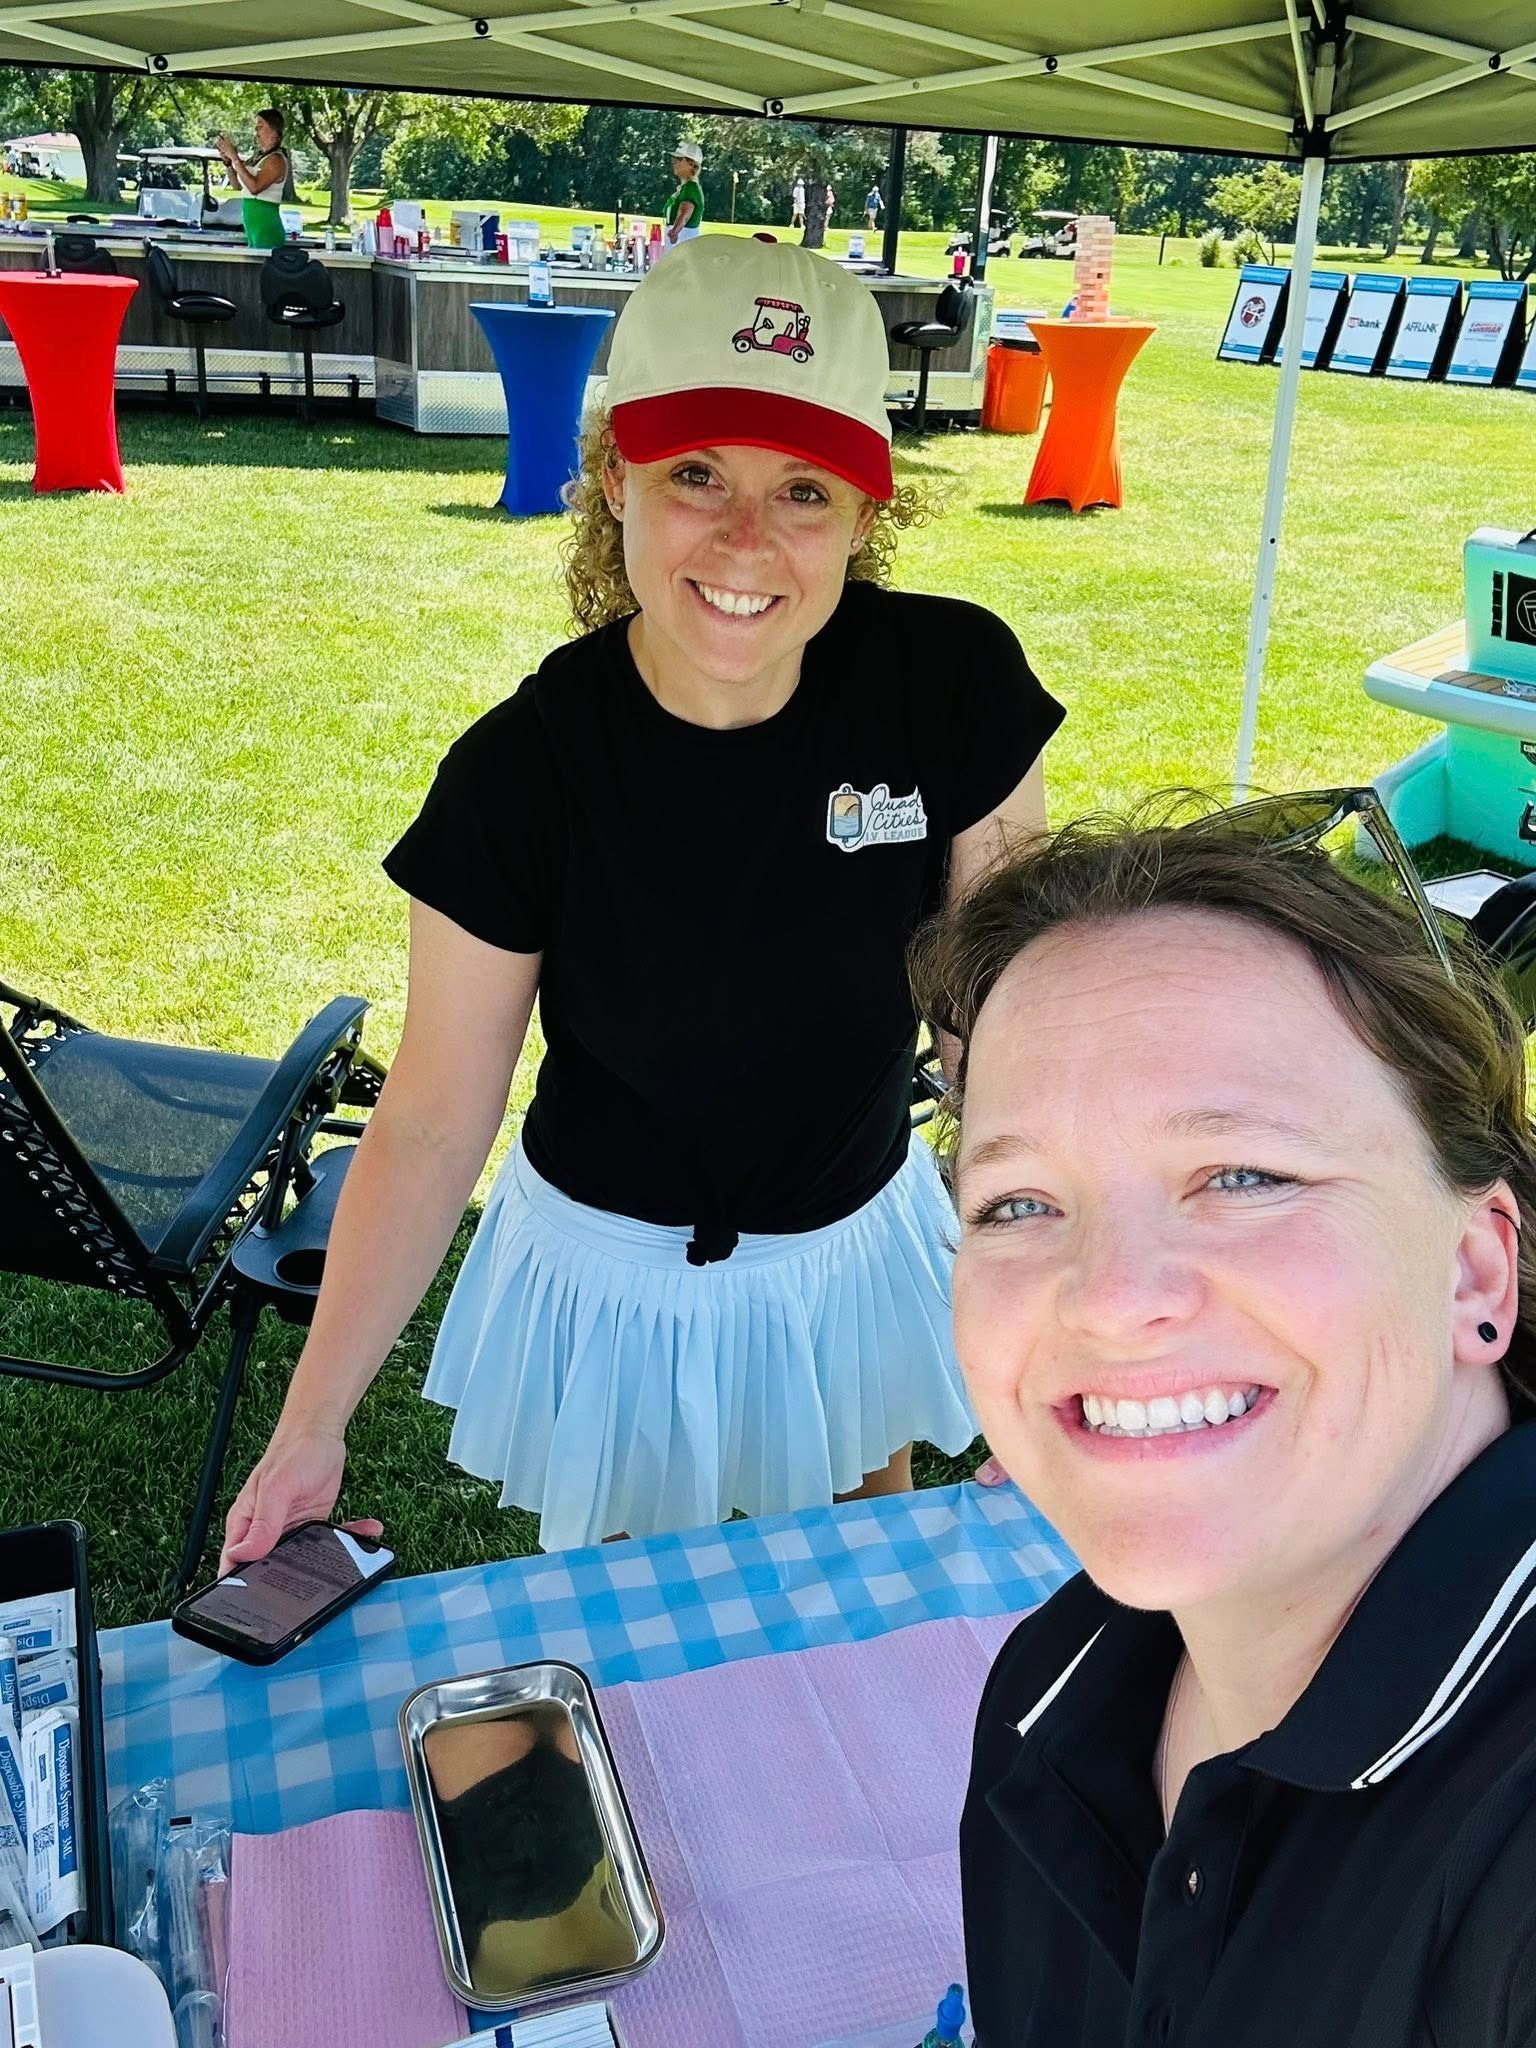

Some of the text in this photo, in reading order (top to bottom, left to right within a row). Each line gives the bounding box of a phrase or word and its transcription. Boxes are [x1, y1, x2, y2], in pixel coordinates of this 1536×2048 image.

[871, 786, 921, 812] Quad
[873, 808, 925, 830] Cities
[57, 1737, 72, 1791] Disposable
[59, 1791, 73, 1830] Syringe
